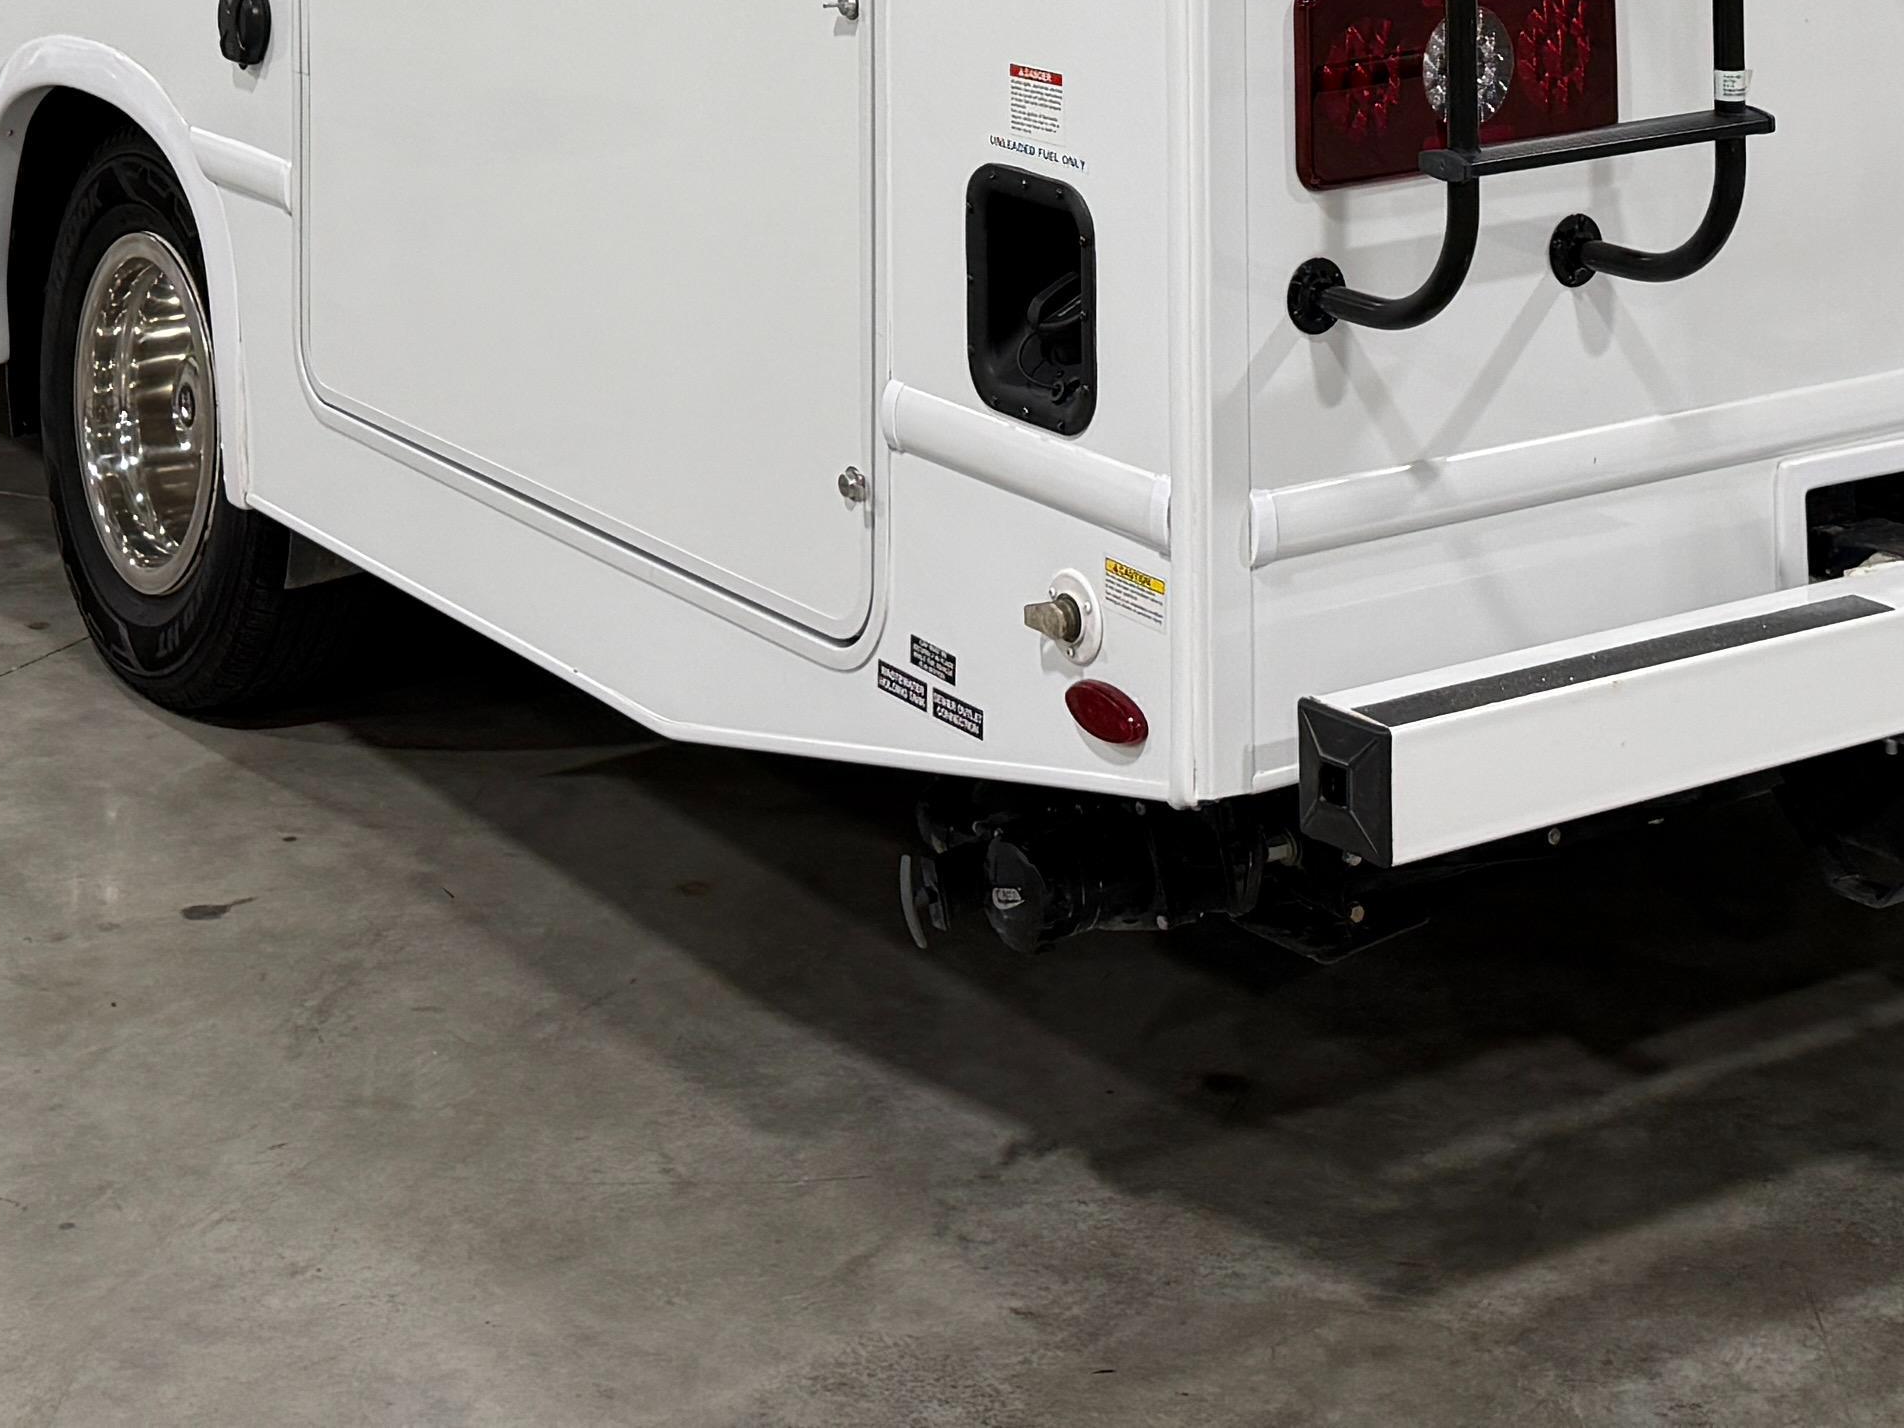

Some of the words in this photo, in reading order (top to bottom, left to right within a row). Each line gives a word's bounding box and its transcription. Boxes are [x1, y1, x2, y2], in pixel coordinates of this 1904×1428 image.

[990, 135, 1036, 156] UNLEADED
[1038, 148, 1060, 163] FUEL
[1062, 155, 1086, 171] ONLY
